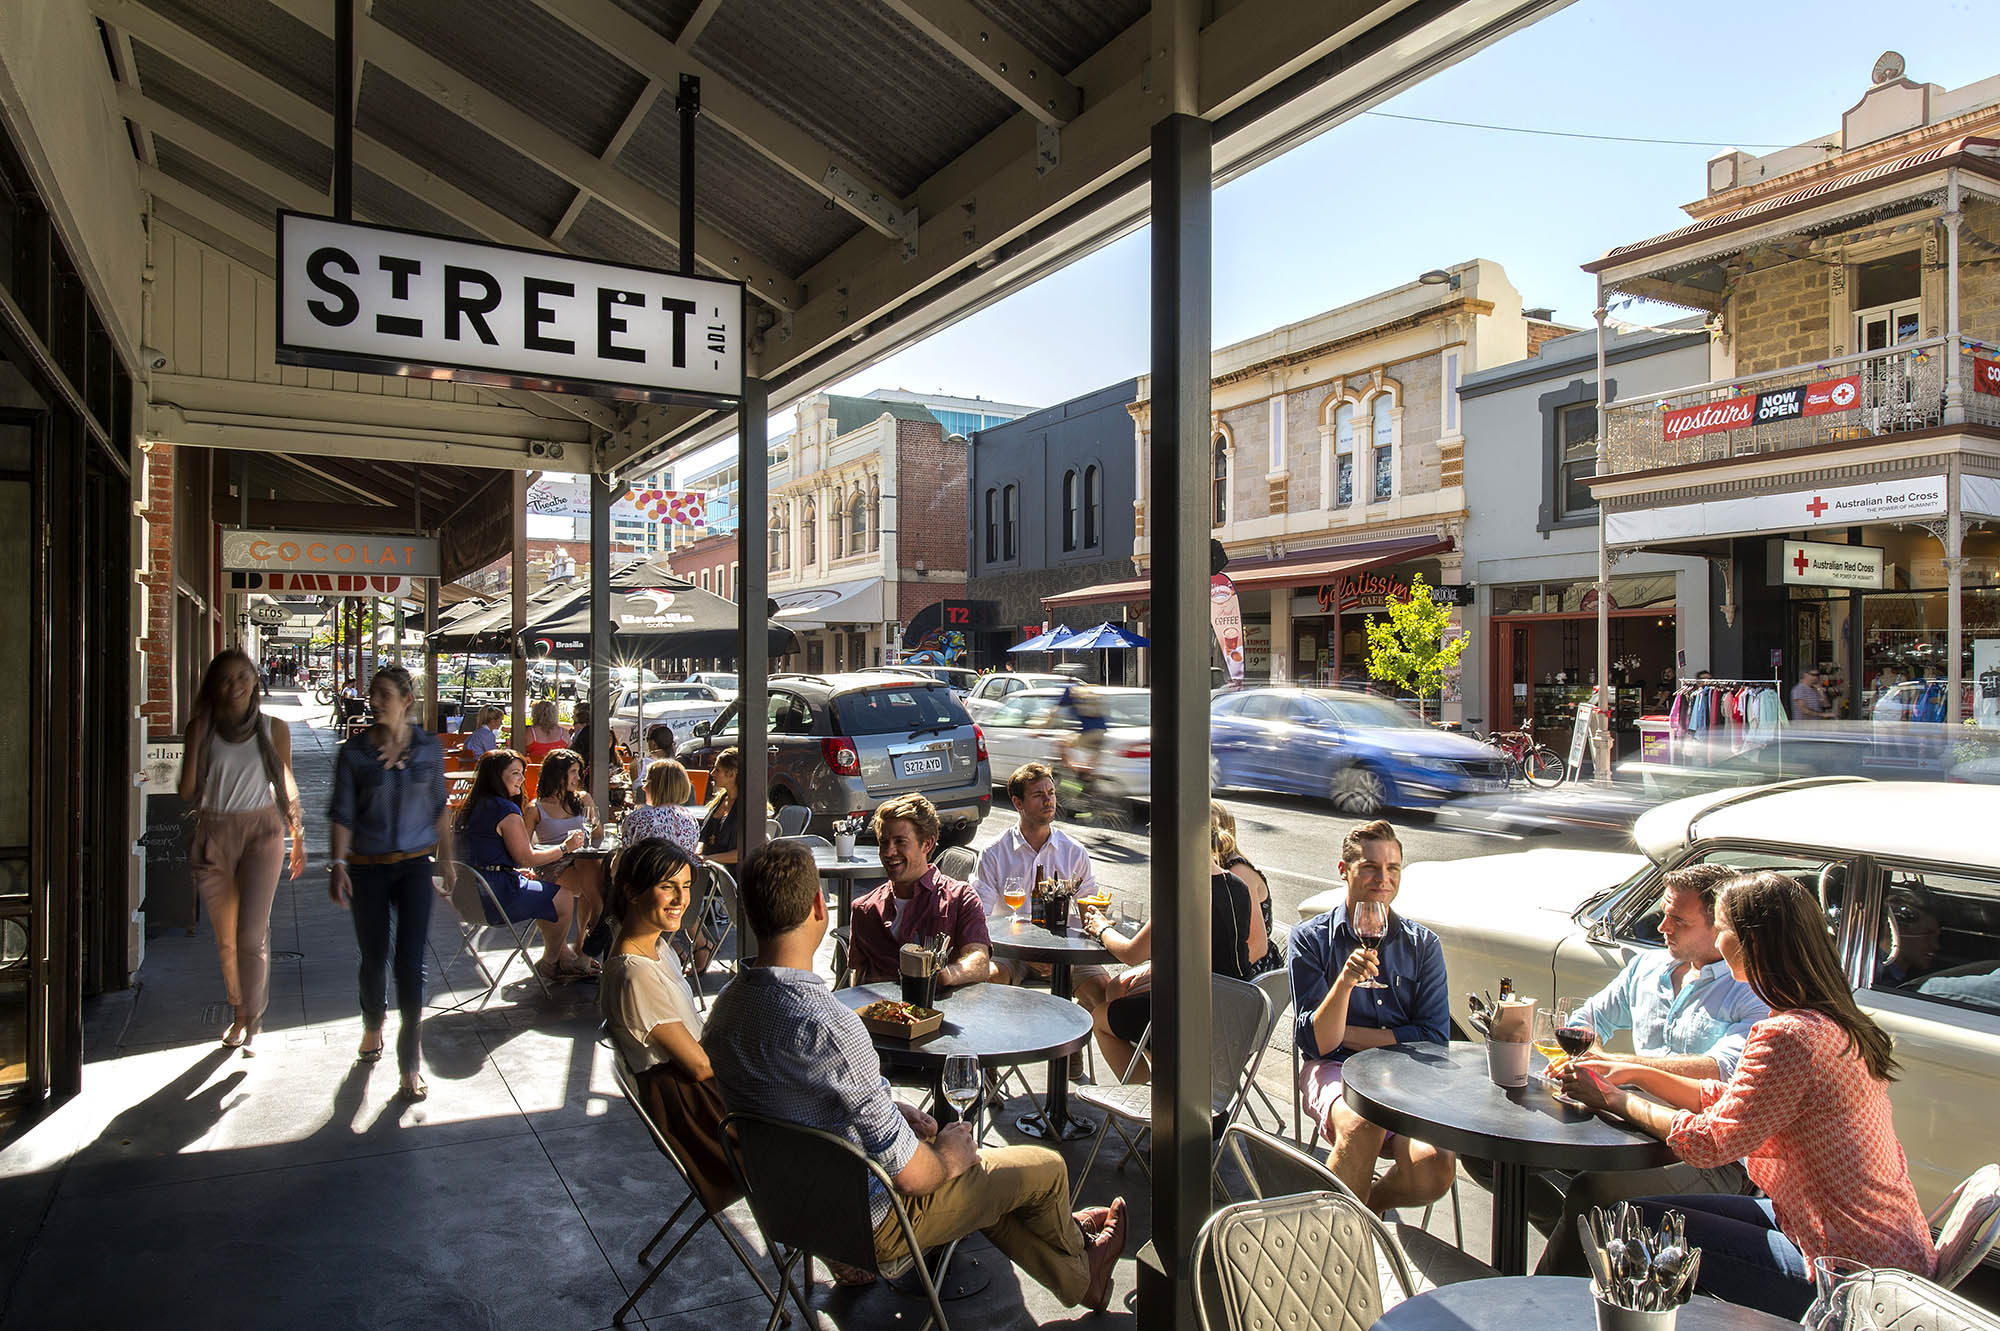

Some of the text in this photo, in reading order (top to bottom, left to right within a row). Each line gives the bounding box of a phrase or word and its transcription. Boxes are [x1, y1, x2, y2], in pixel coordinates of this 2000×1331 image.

[306, 246, 697, 369] STREET
[1761, 391, 1797, 409] NOW
[1759, 401, 1799, 419] OPEN
[1666, 403, 1752, 438] upstairs
[526, 496, 568, 511] Theatre
[1835, 491, 1939, 509] Australian Red Cross
[1908, 501, 1939, 509] HUMANITY
[249, 540, 416, 567] COCOLAT
[1813, 559, 1875, 573] Australian Red Cross
[1317, 572, 1413, 613] Gelatissim
[947, 607, 969, 624] T2
[1214, 616, 1239, 626] COFFEE
[555, 641, 584, 650] Brasilia
[147, 747, 185, 760] ellar
[905, 761, 924, 773] S272
[926, 759, 941, 770] AYD
